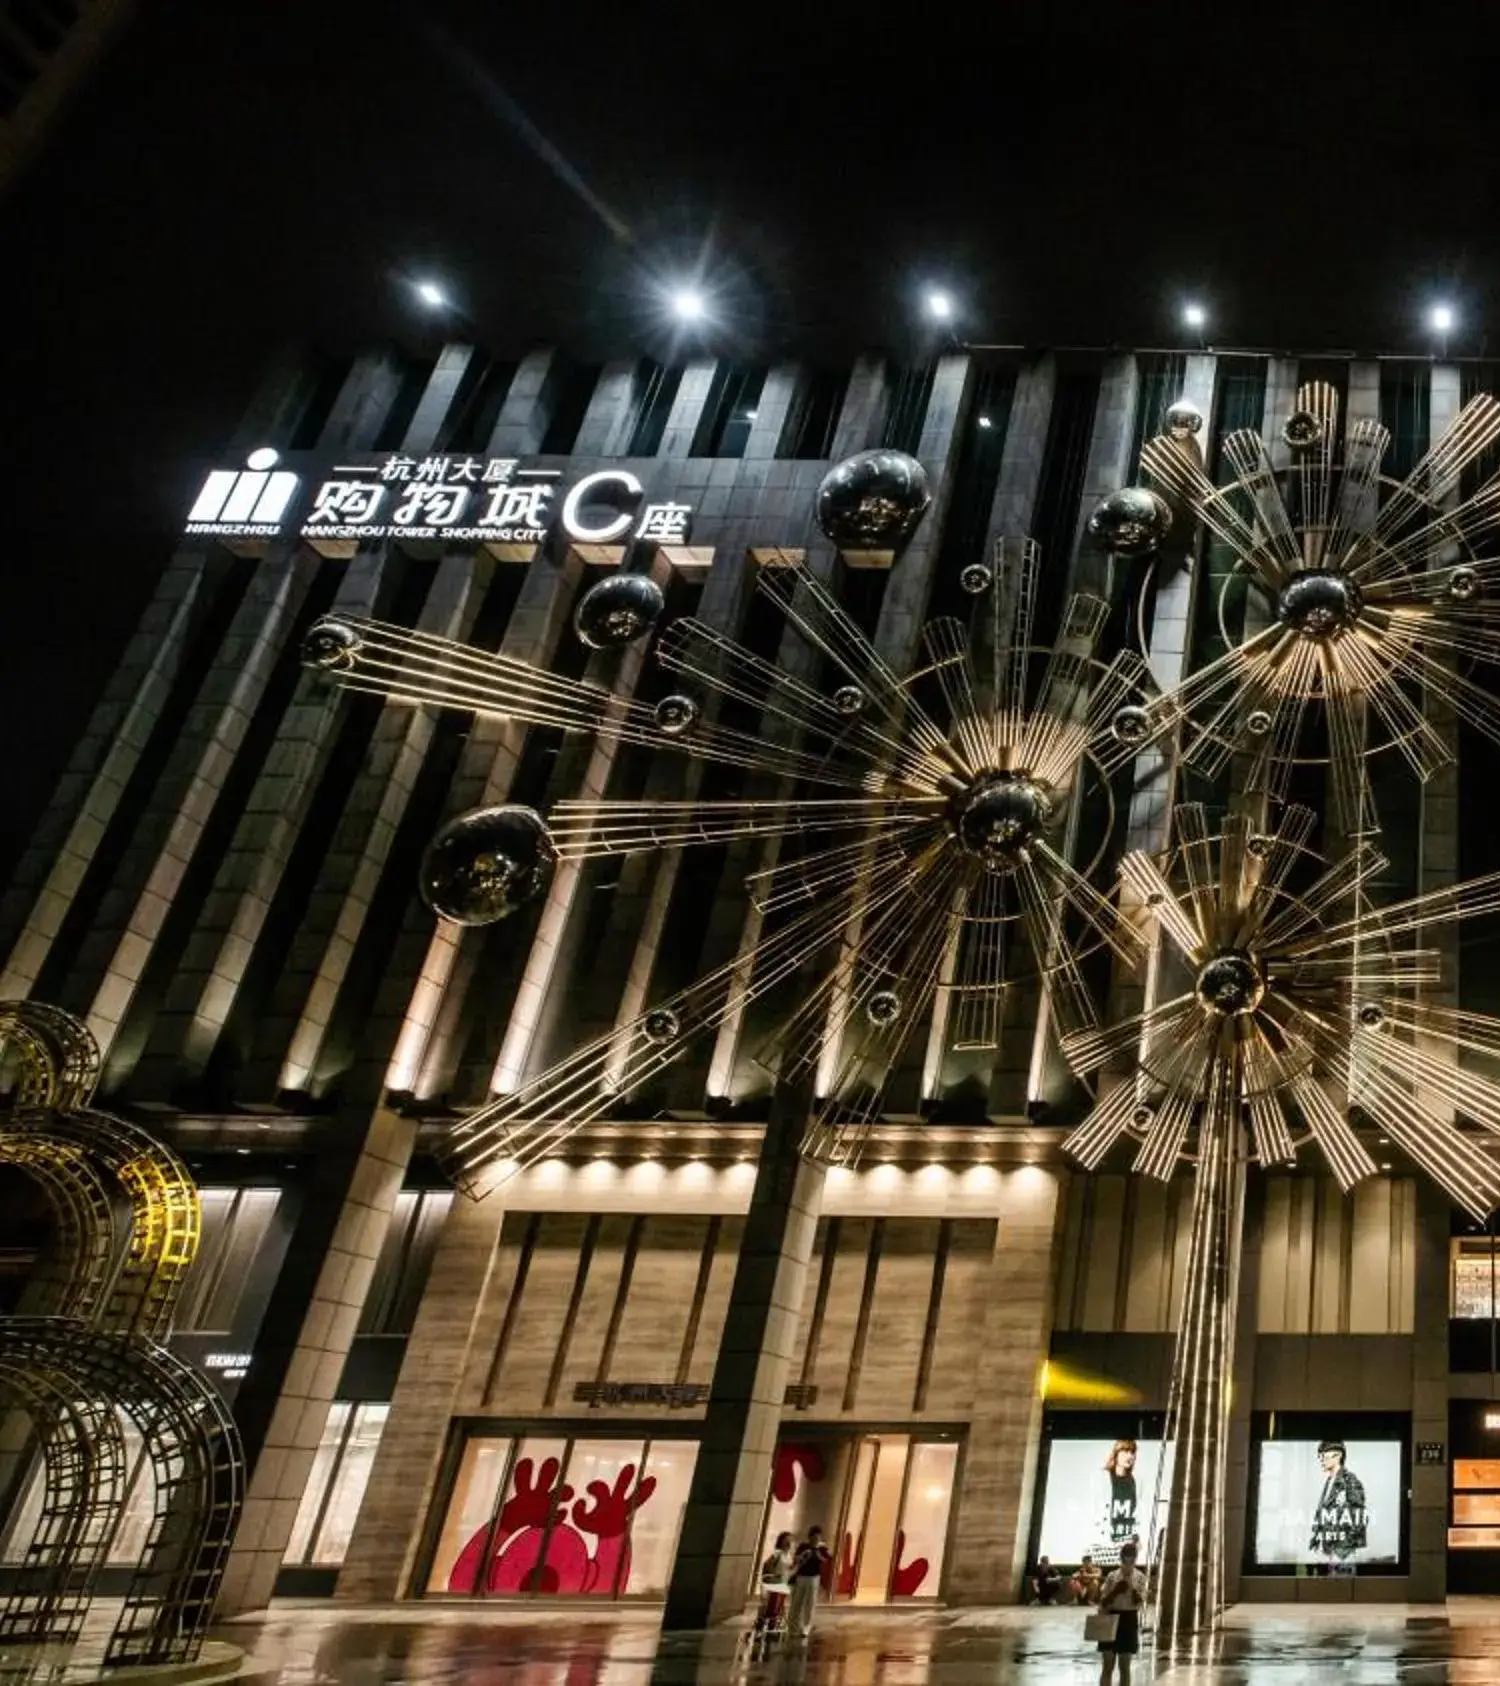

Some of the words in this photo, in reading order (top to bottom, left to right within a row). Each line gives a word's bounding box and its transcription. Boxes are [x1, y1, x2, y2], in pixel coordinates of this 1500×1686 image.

[382, 457, 517, 482] 杭州大厦
[186, 524, 280, 535] HANGZHOU
[301, 525, 384, 536] HANGZHOU
[387, 527, 436, 538] TOWER
[440, 527, 512, 540] SHOPPING
[513, 529, 547, 541] CITY
